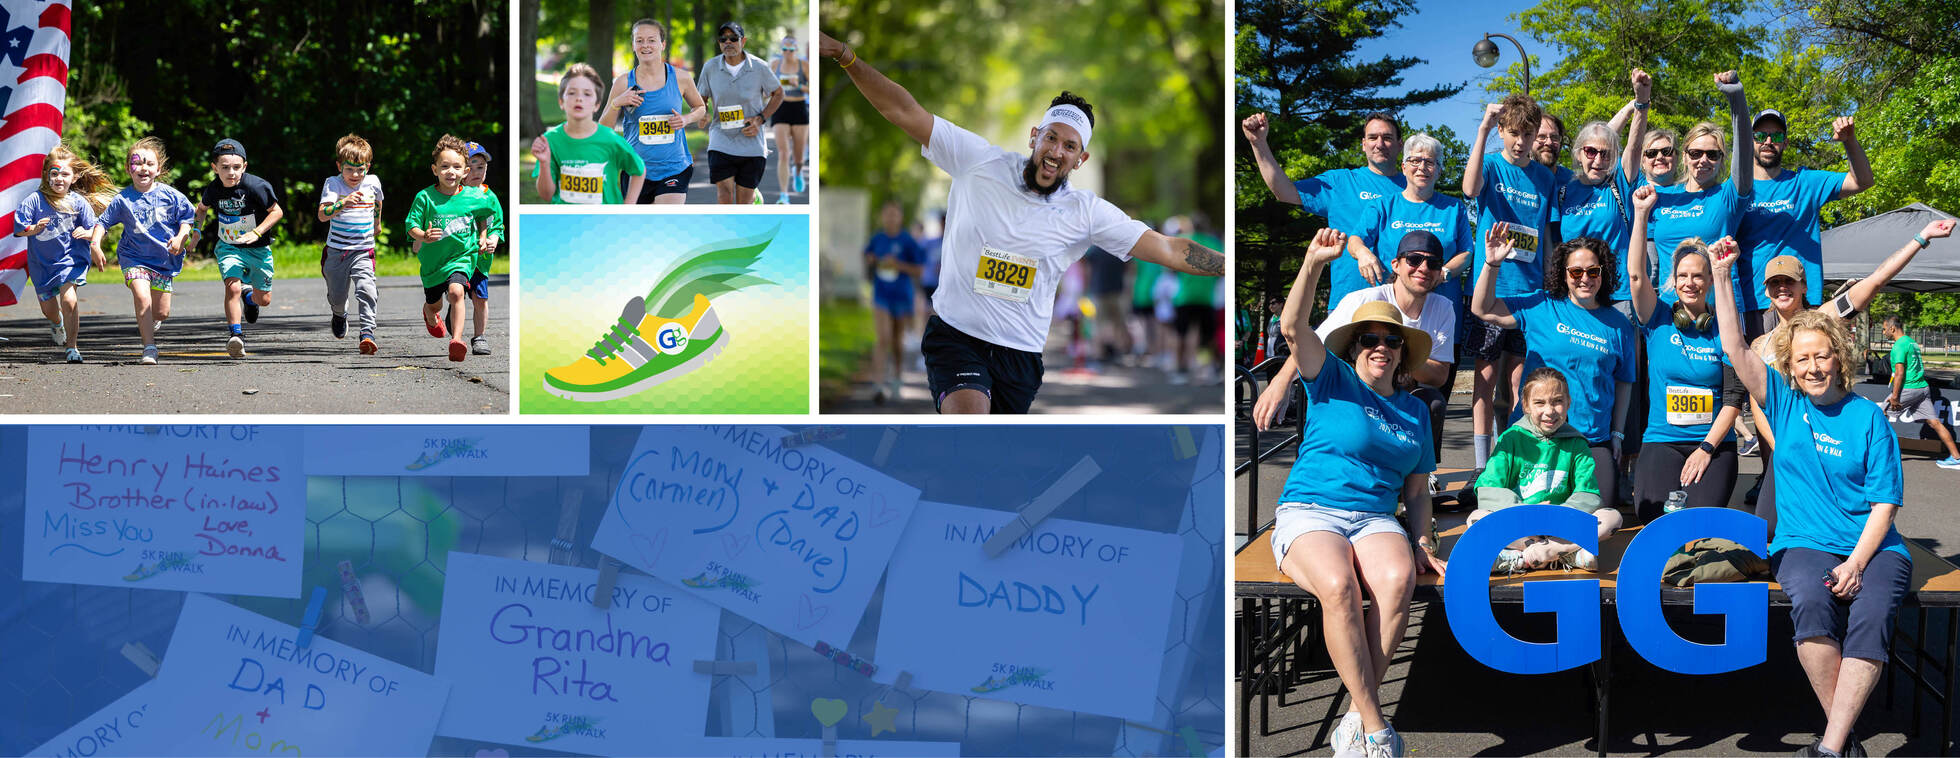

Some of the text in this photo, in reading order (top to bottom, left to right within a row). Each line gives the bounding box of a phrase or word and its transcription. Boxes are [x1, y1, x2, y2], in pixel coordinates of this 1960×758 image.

[720, 111, 740, 122] 3947
[643, 121, 671, 135] 3945
[564, 175, 599, 193] 3930
[984, 258, 1029, 287] 3829
[1570, 328, 1590, 339] GOOD
[1590, 334, 1608, 345] GRIEF
[1671, 395, 1706, 413] 3961
[230, 425, 260, 441] OF
[1819, 433, 1843, 446] GRIEF
[424, 438, 466, 449] 5K RUN
[455, 449, 488, 459] WALK
[723, 425, 836, 485] MEMORY
[836, 477, 867, 500] OF
[58, 442, 280, 492] Henry Haines
[64, 482, 177, 511] Brother
[791, 482, 860, 542] DAD
[43, 509, 153, 543] Miss You
[194, 532, 287, 562] Donna
[944, 522, 1130, 564] IN MMORY OF
[141, 549, 184, 561] 5K RUN
[173, 562, 205, 575] WALK
[706, 560, 723, 575] 5K
[495, 575, 518, 594] IN
[642, 594, 673, 614] OF
[957, 570, 1100, 626] DADDY
[489, 602, 672, 667] Grandma
[226, 623, 400, 697] IN MEMORY OF
[992, 662, 1007, 673] 5K
[228, 656, 327, 711] DAD
[531, 655, 619, 703] Rita
[1022, 679, 1056, 690] WALK
[545, 711, 560, 722] 5K
[201, 711, 300, 757] Mom
[575, 727, 607, 740] WALK
